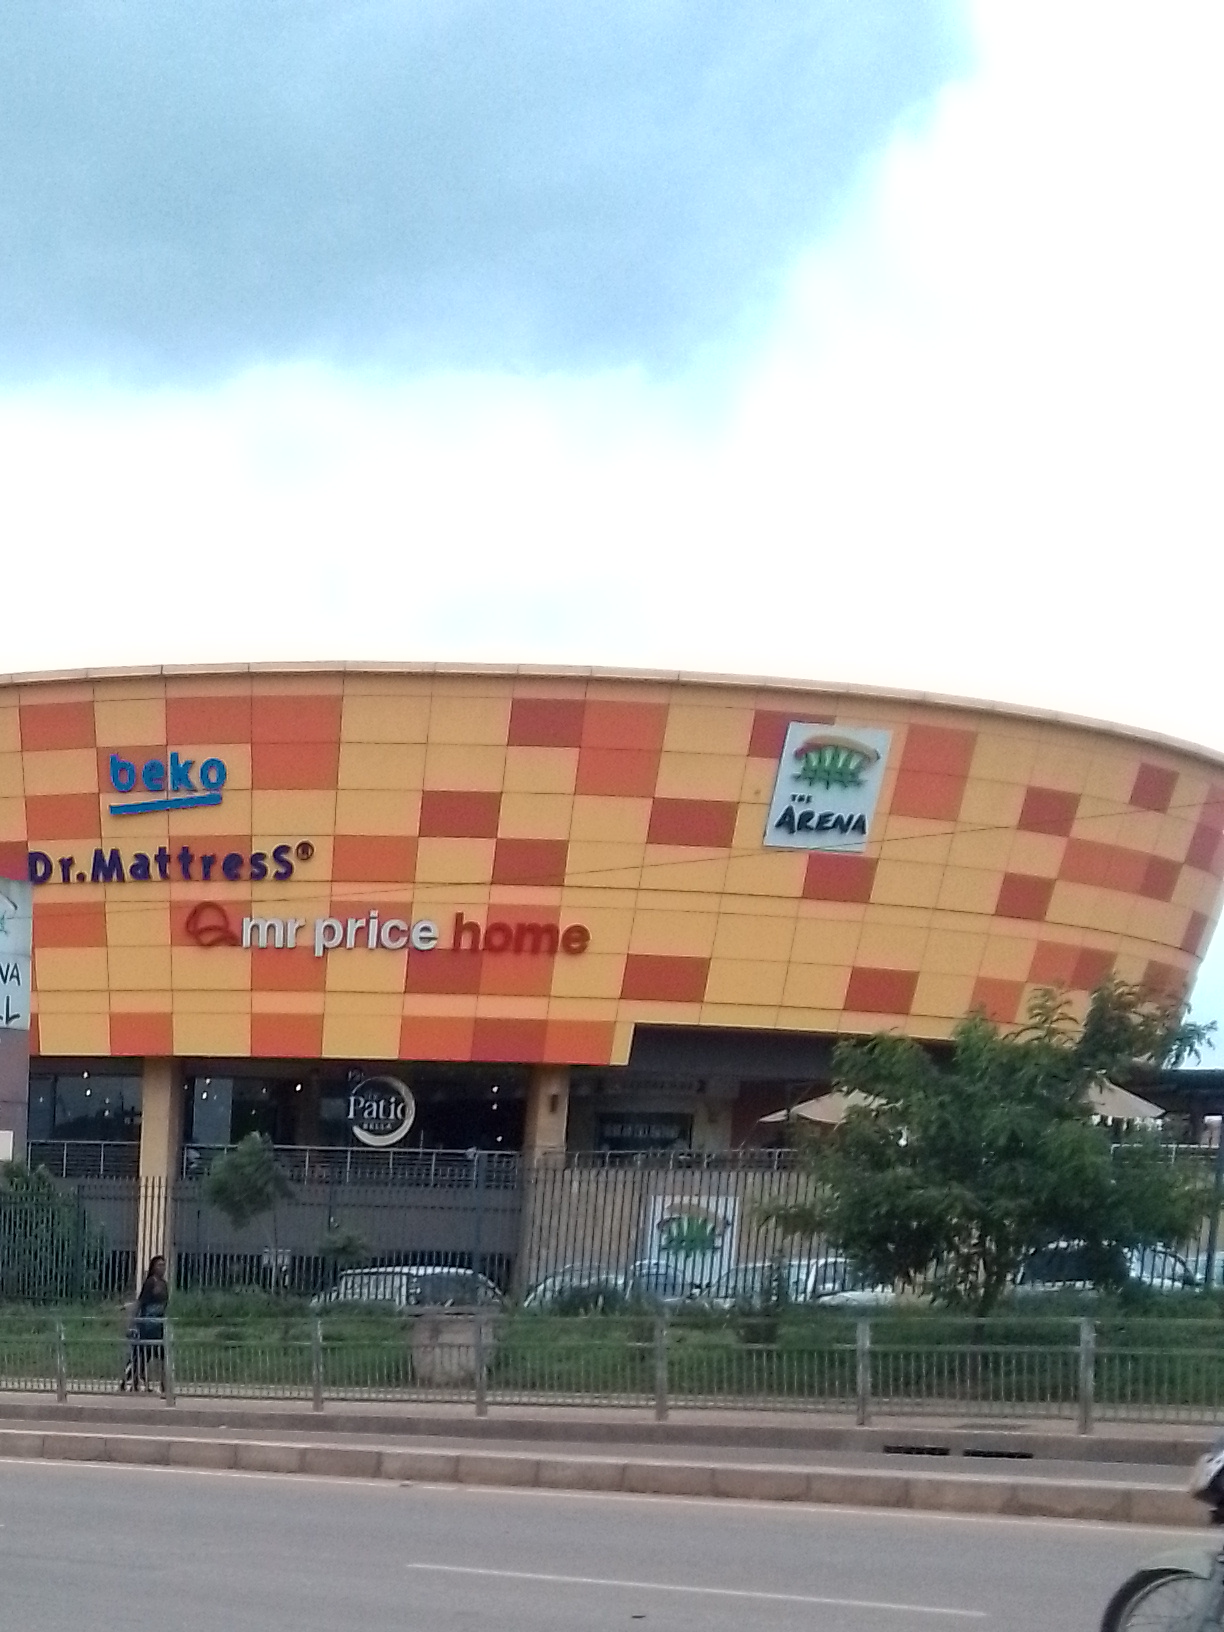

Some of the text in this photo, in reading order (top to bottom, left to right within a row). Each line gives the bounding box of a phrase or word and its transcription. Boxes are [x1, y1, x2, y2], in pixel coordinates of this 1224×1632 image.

[109, 752, 227, 792] beko
[775, 804, 867, 835] ARENA
[241, 909, 593, 957] mr price home
